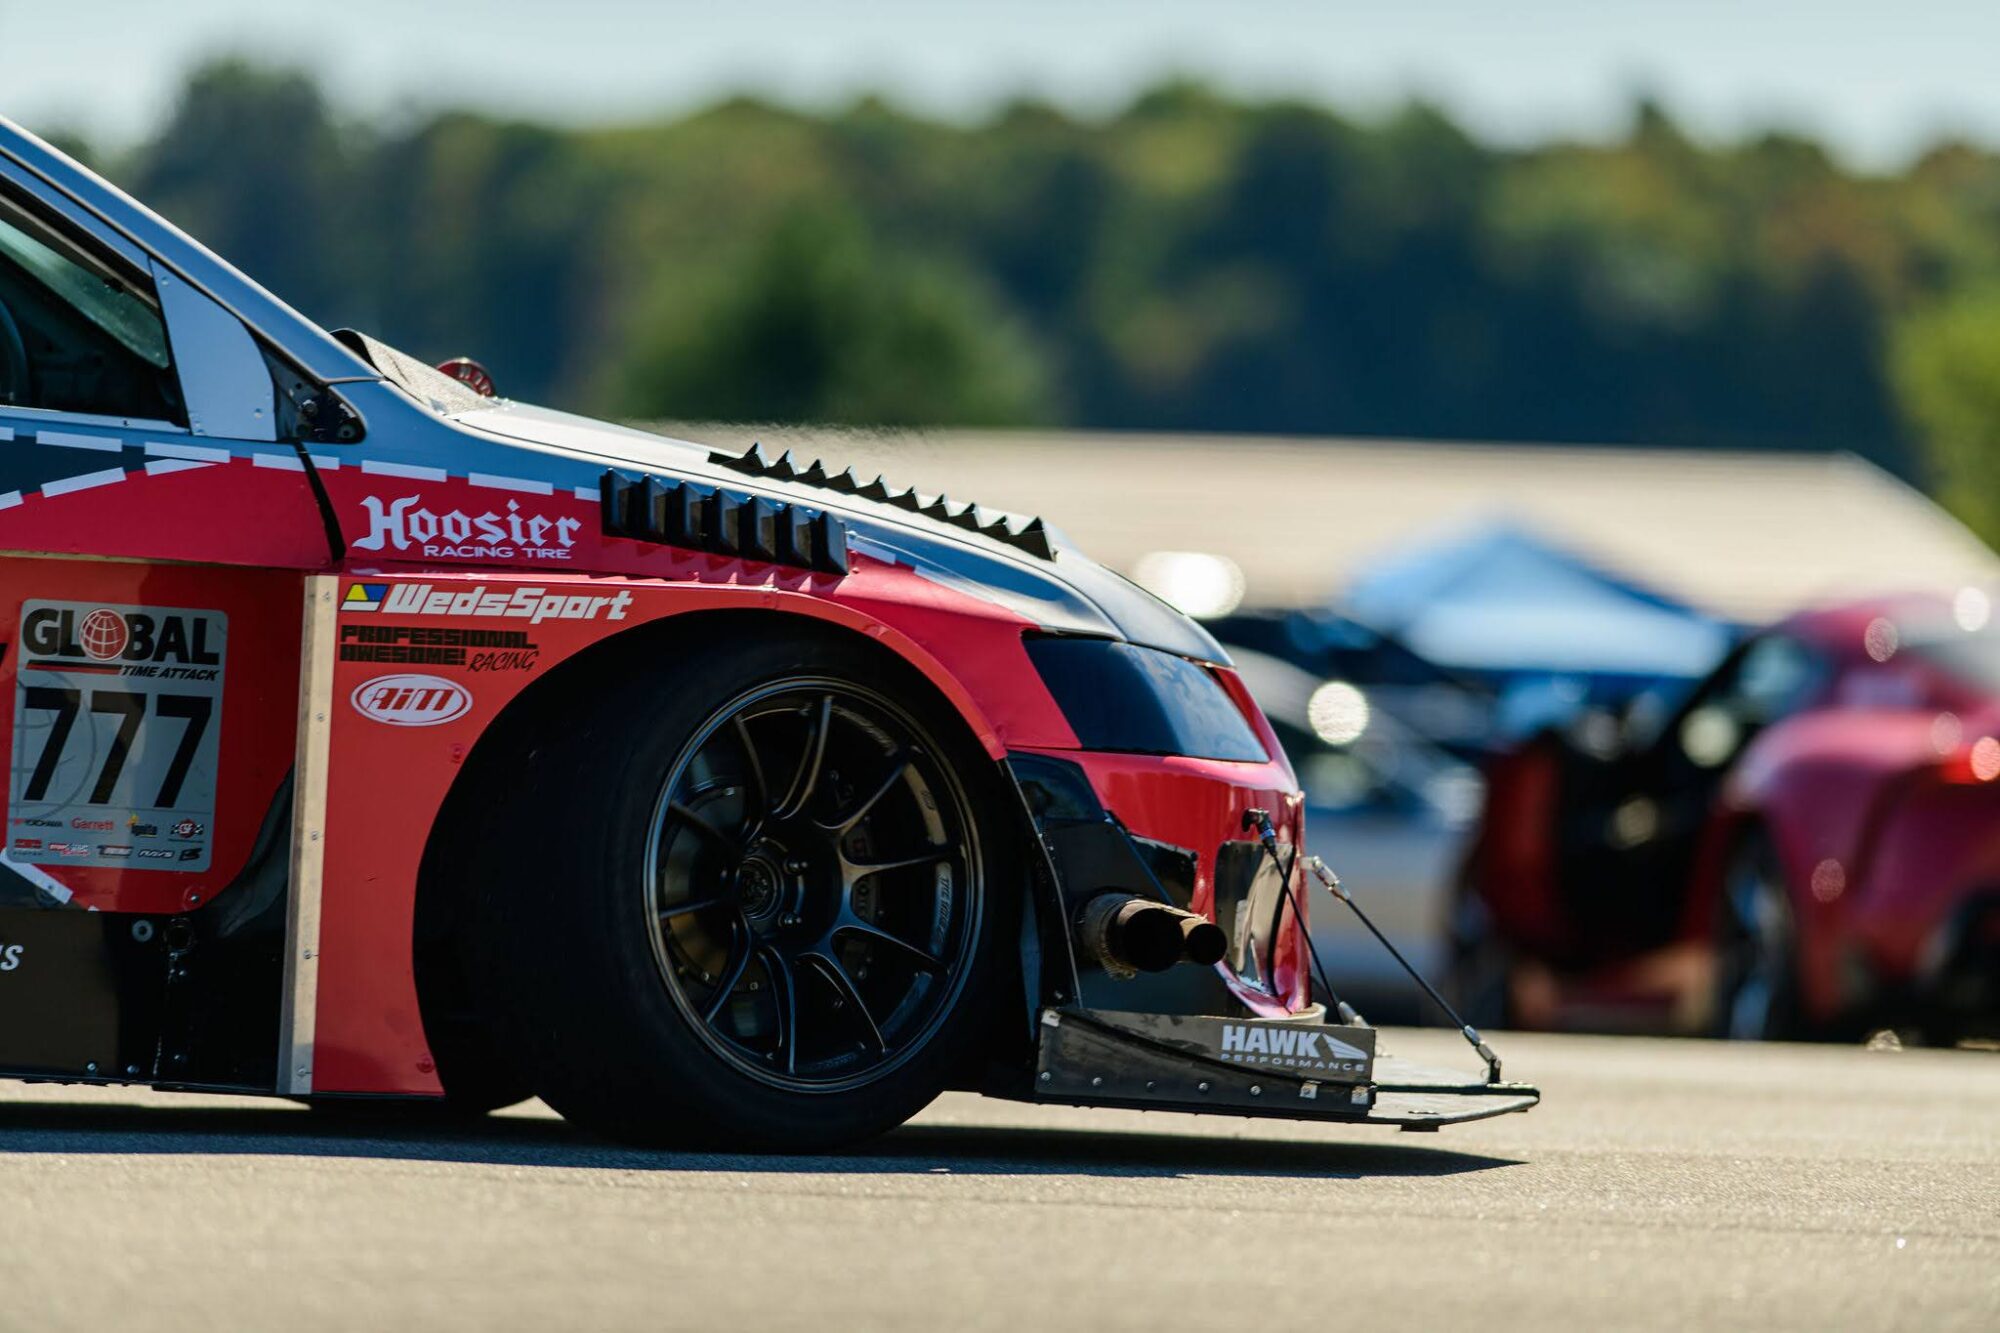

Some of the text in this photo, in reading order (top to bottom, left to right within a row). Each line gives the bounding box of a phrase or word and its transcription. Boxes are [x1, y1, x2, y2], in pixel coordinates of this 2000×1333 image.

[352, 493, 582, 550] Hoosier
[423, 545, 572, 560] RACING TIRE
[382, 583, 634, 624] WedsSport
[22, 607, 220, 665] GLOBAL
[341, 624, 539, 650] PROFESSIONAL
[340, 643, 540, 672] AWESOME! RACING
[121, 664, 220, 682] TIME ATTACK
[23, 686, 214, 809] 777
[71, 816, 114, 832] Garrett
[1222, 1025, 1321, 1058] HAWK
[1219, 1053, 1366, 1073] PERFORMANCE
